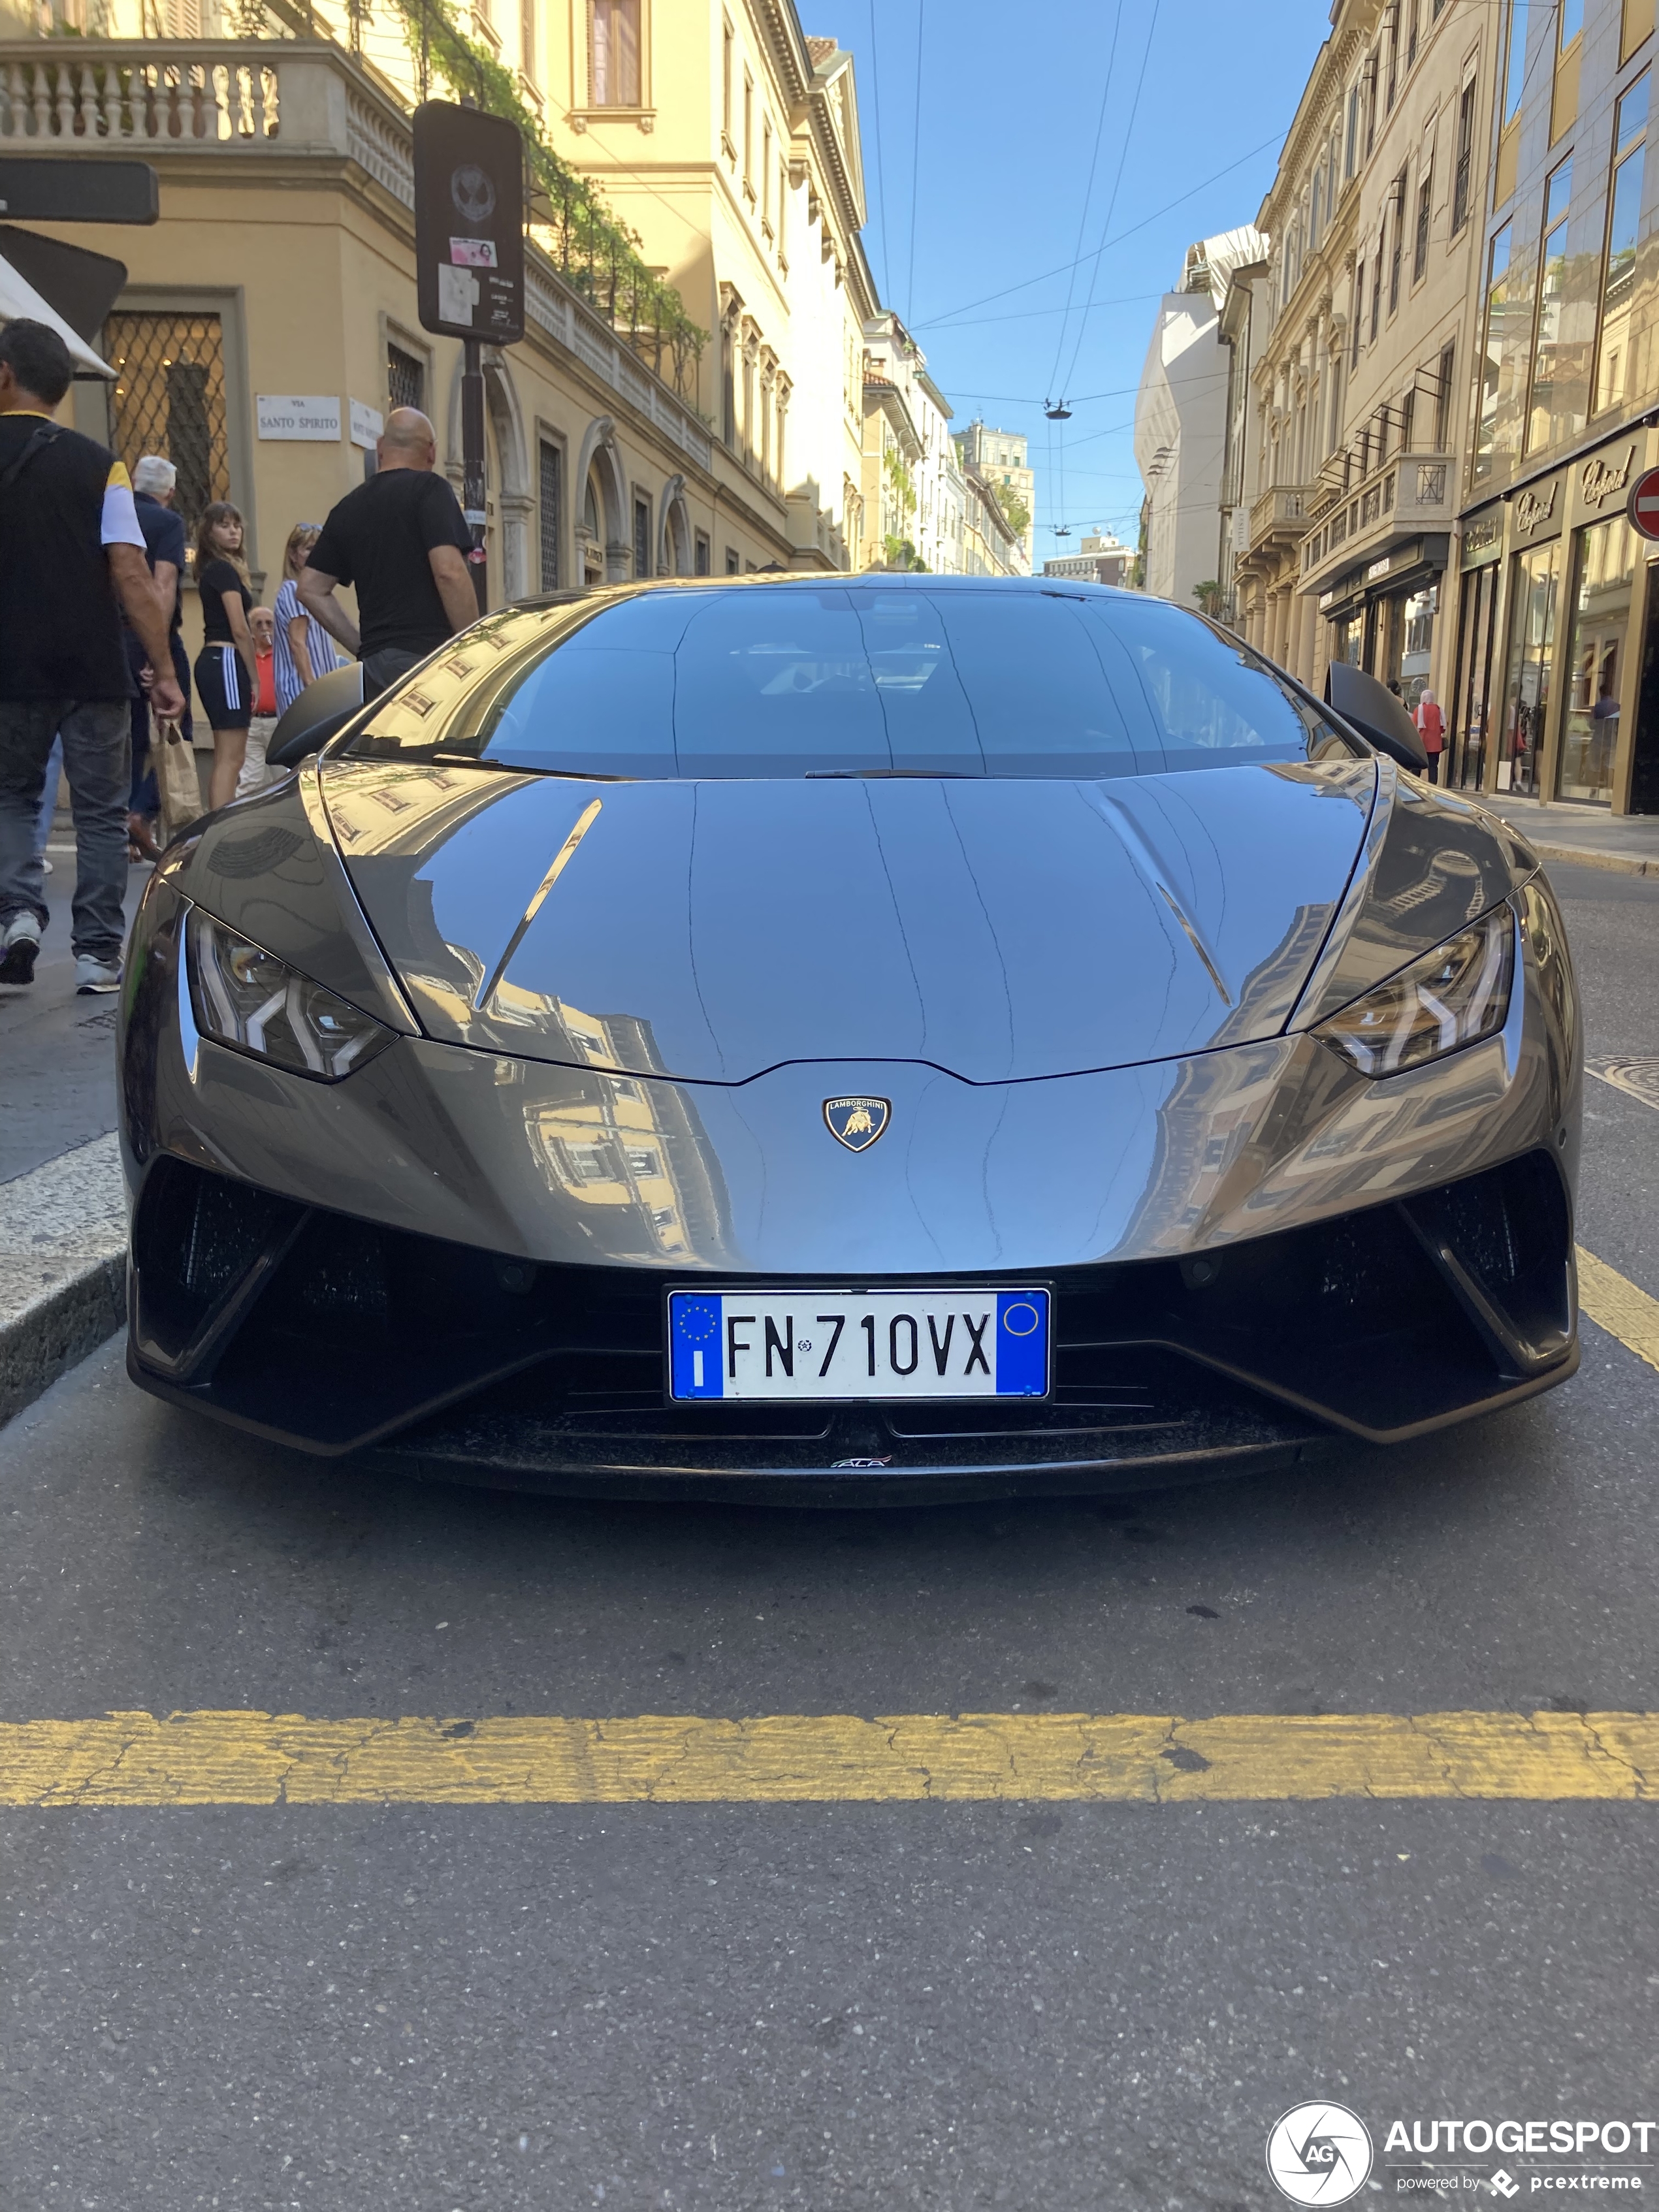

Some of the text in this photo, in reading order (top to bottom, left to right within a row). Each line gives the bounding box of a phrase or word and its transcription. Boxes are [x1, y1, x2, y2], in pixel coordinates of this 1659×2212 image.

[260, 417, 338, 429] SANTO SPIRITO
[830, 1100, 883, 1110] LAMBORGHINI
